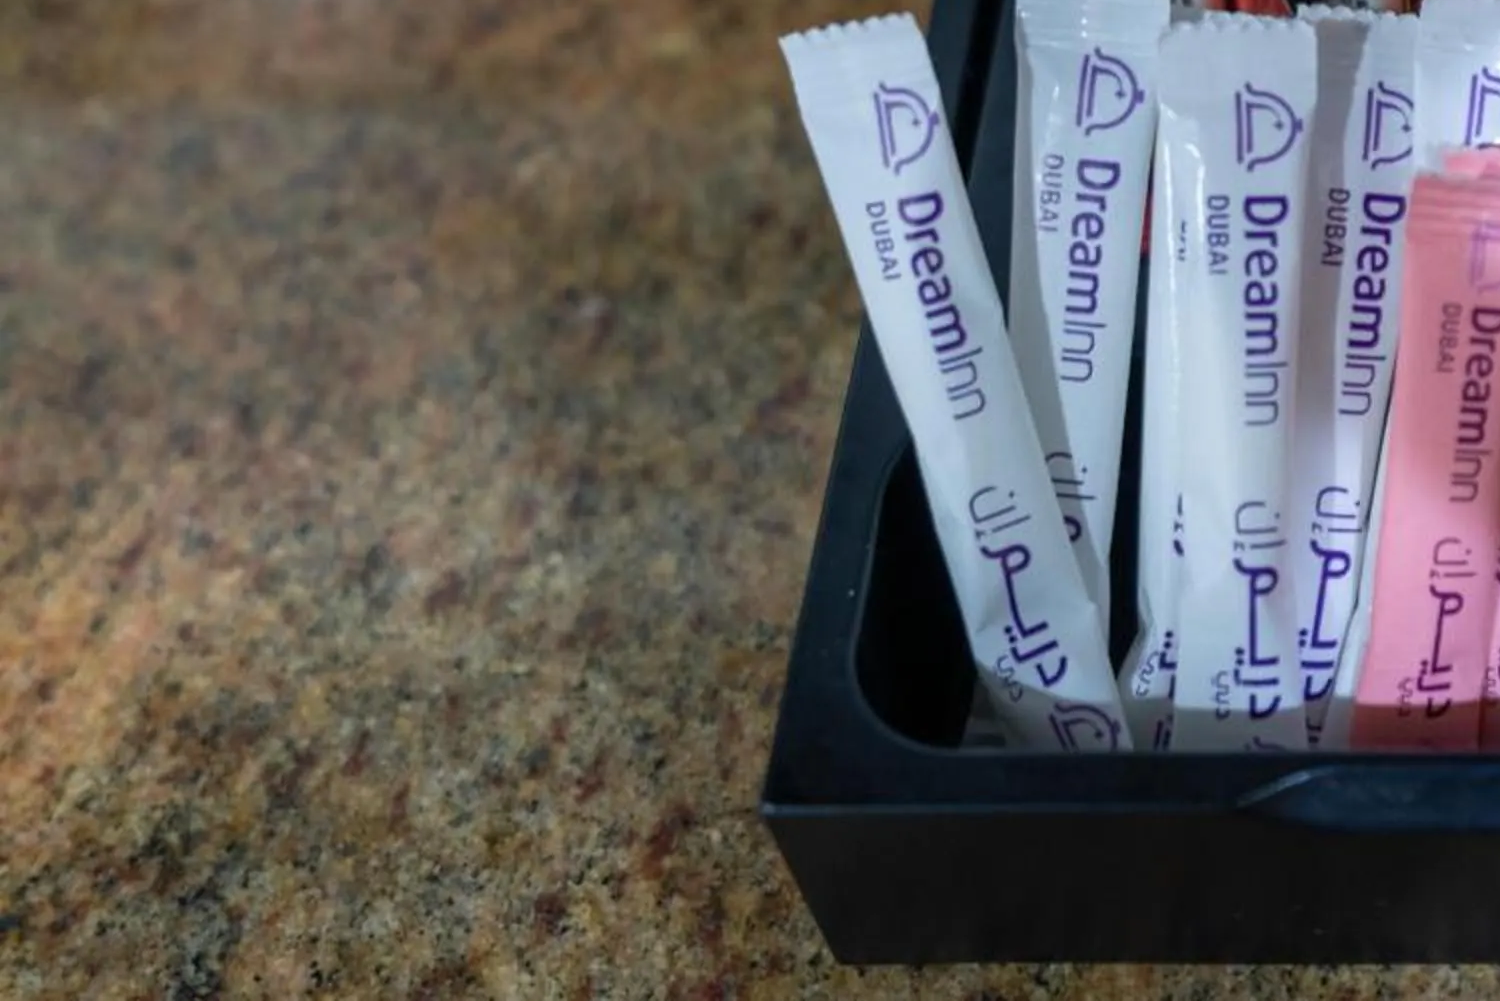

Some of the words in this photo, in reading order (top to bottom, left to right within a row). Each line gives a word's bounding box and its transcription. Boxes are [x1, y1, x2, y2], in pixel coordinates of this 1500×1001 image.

[1039, 154, 1065, 233] DUBAI
[1321, 188, 1351, 267] DUBAI
[866, 202, 901, 281] DUBAI
[1061, 158, 1121, 384] DreamInn
[1207, 195, 1231, 276] DUBAI
[899, 191, 987, 420] DreamInn
[1242, 194, 1289, 428] DreamInn
[1338, 192, 1407, 417] DreamInn
[1436, 303, 1463, 374] DUBAI
